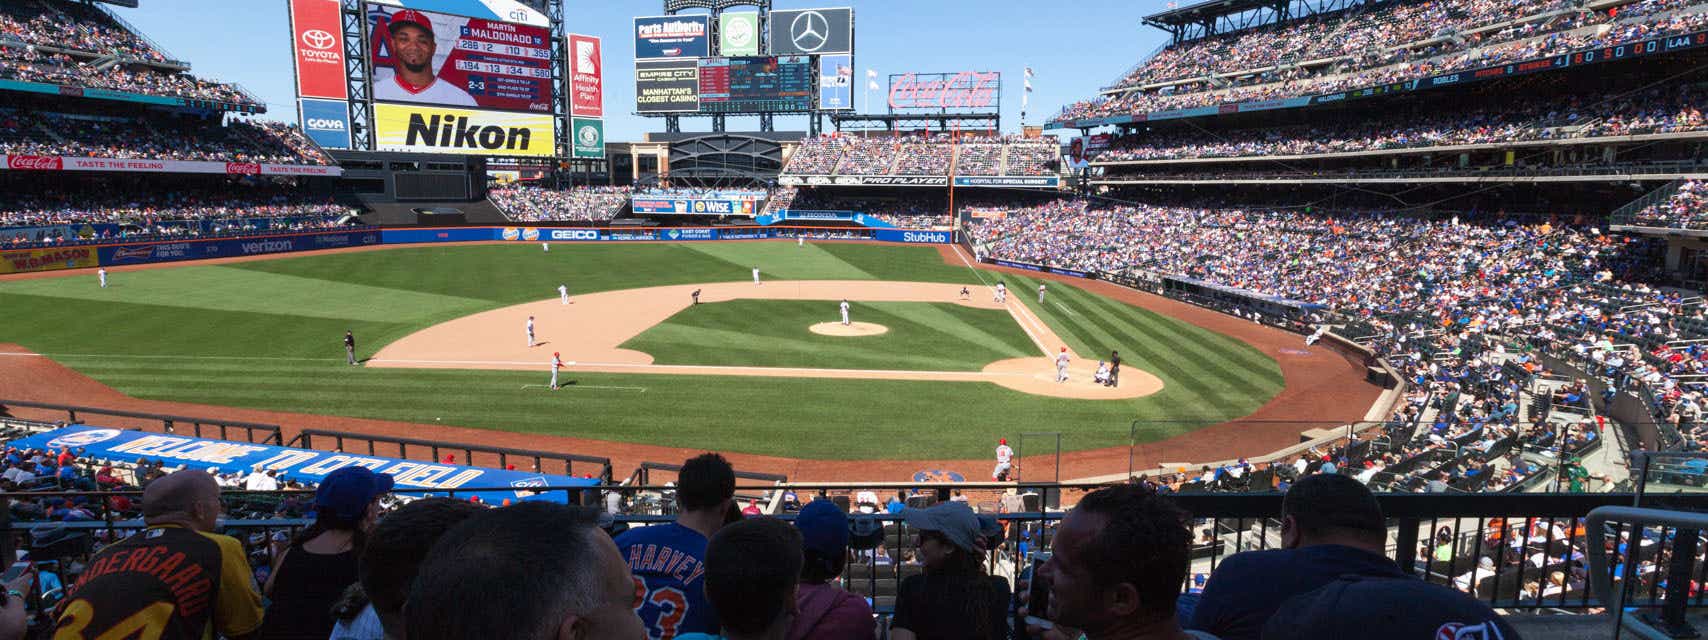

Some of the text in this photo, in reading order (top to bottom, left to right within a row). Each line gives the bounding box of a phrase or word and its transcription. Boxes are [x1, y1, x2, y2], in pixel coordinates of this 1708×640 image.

[638, 21, 704, 34] Parts Authority
[471, 28, 532, 45] MALDONADO
[1647, 41, 1657, 52] 0
[1669, 37, 1690, 48] LAA
[301, 49, 340, 59] TOYOTA
[1585, 51, 1594, 62] 0
[1615, 46, 1624, 57] 0
[468, 80, 485, 90] 2-3
[574, 74, 599, 85] Affinity
[1433, 74, 1459, 85] ROBLES
[576, 83, 598, 92] Health
[643, 87, 692, 96] MANHATTAN'S
[888, 72, 997, 108] Coca-Cola
[580, 91, 594, 101] Plan
[638, 95, 697, 103] CLOSEST CASINO
[308, 118, 344, 129] GOYA
[406, 113, 531, 150] Nikon
[10, 155, 58, 169] Coca-Cola
[76, 160, 105, 168] TASTE
[107, 161, 125, 169] THE
[228, 162, 258, 174] Coca-Cola
[892, 177, 946, 185] PLAYER
[705, 201, 730, 213] WISE
[552, 230, 597, 240] GEICO
[904, 232, 945, 243] StubHub
[241, 239, 292, 253] verizon
[106, 434, 268, 464] WELCOME
[250, 450, 319, 470] TO
[381, 461, 485, 489] FIELD
[627, 543, 705, 586] HARVEY
